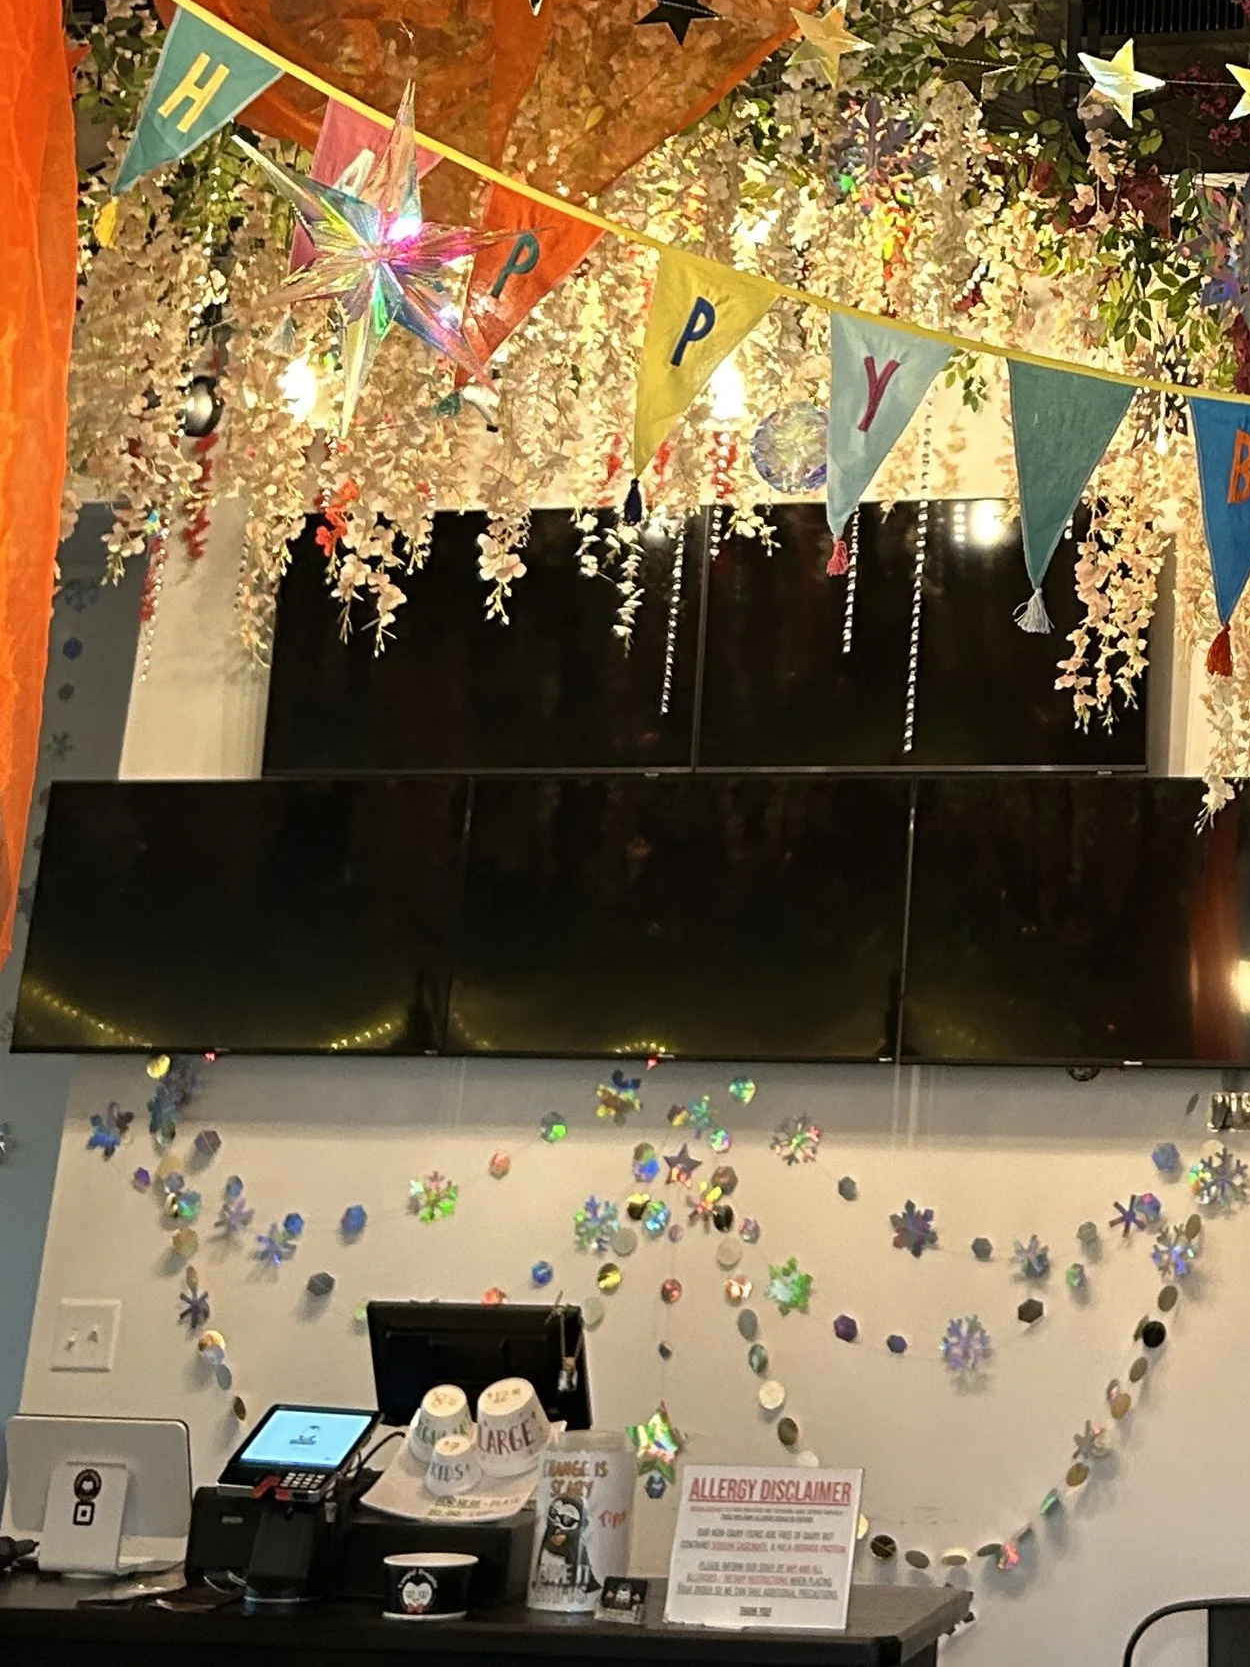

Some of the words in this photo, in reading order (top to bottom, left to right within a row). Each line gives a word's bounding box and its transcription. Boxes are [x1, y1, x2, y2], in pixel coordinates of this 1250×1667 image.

[595, 1460, 609, 1478] IS
[690, 1477, 759, 1501] ALLERGY
[760, 1480, 852, 1504] DISCLAIMER
